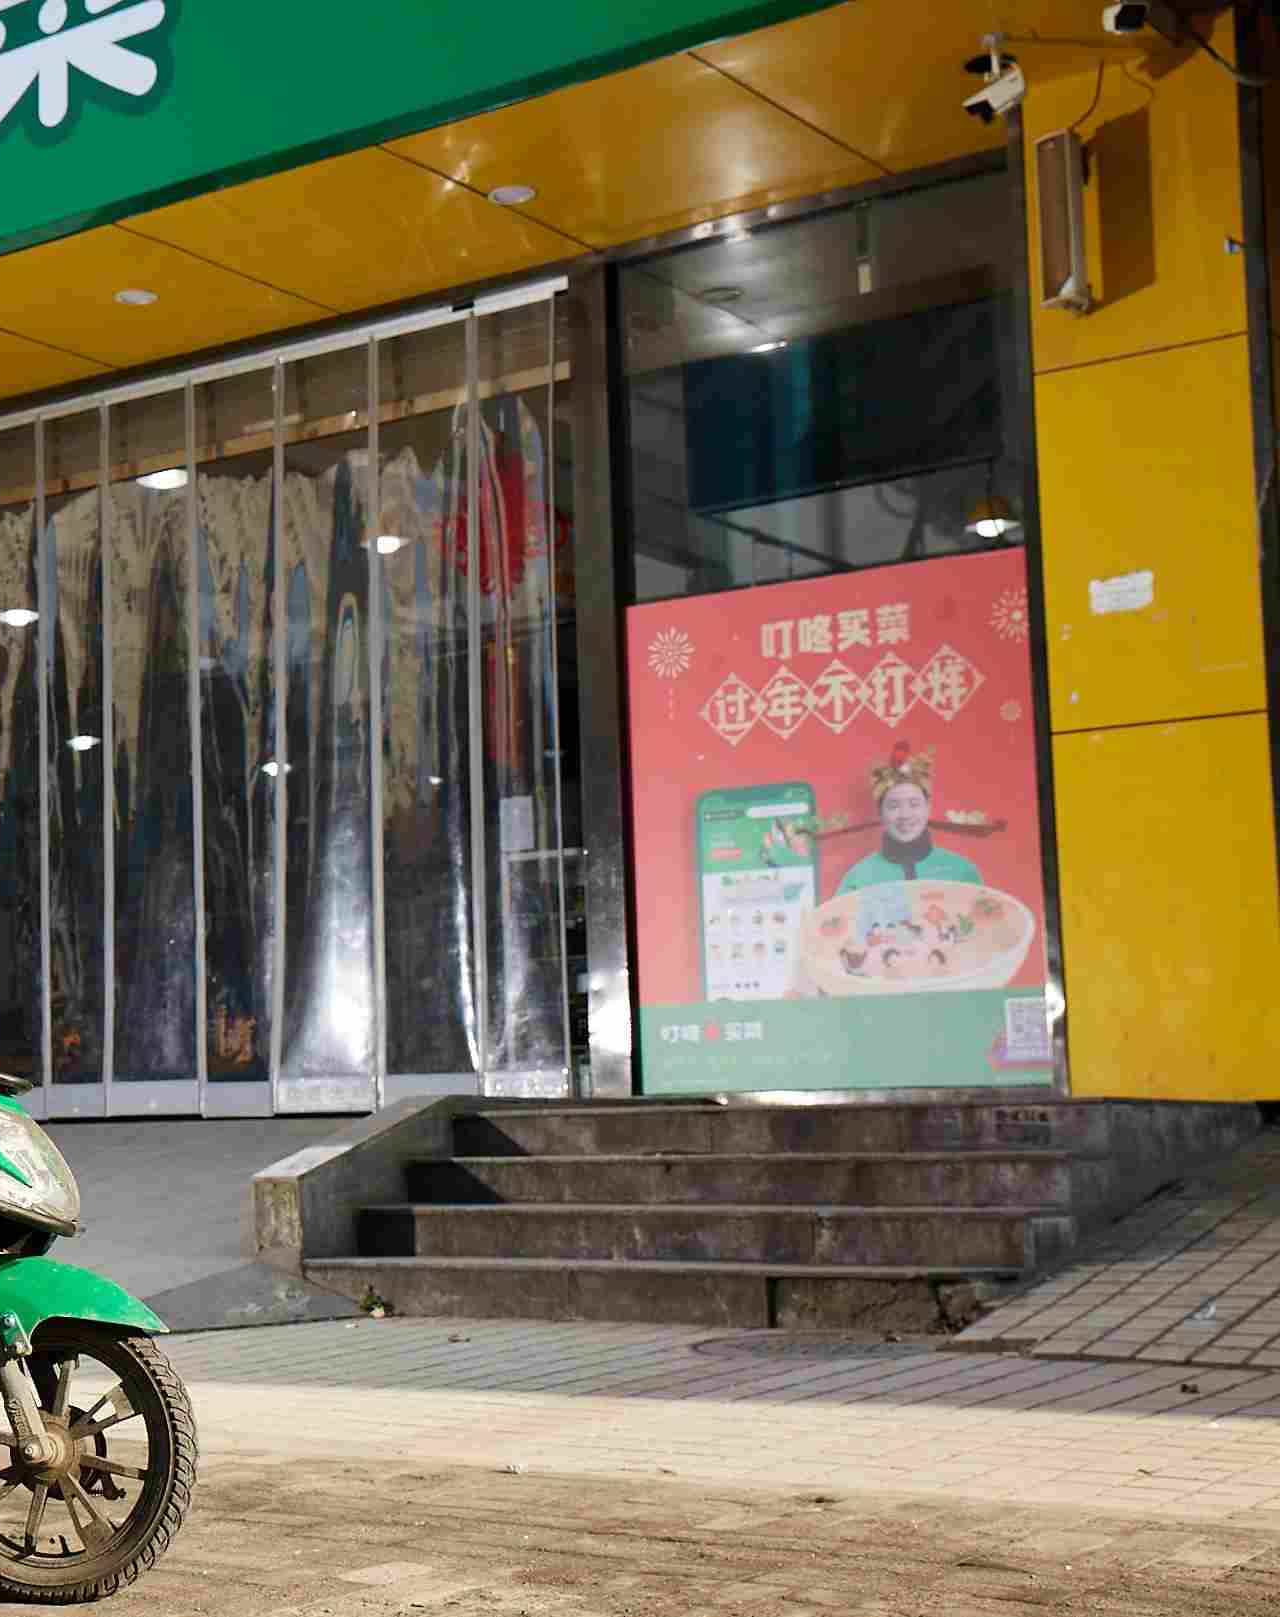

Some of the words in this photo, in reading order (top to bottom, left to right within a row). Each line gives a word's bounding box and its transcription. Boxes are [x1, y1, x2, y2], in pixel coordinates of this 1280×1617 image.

[761, 602, 911, 660] 叮咚买菜
[713, 655, 967, 732] 过年不打烊
